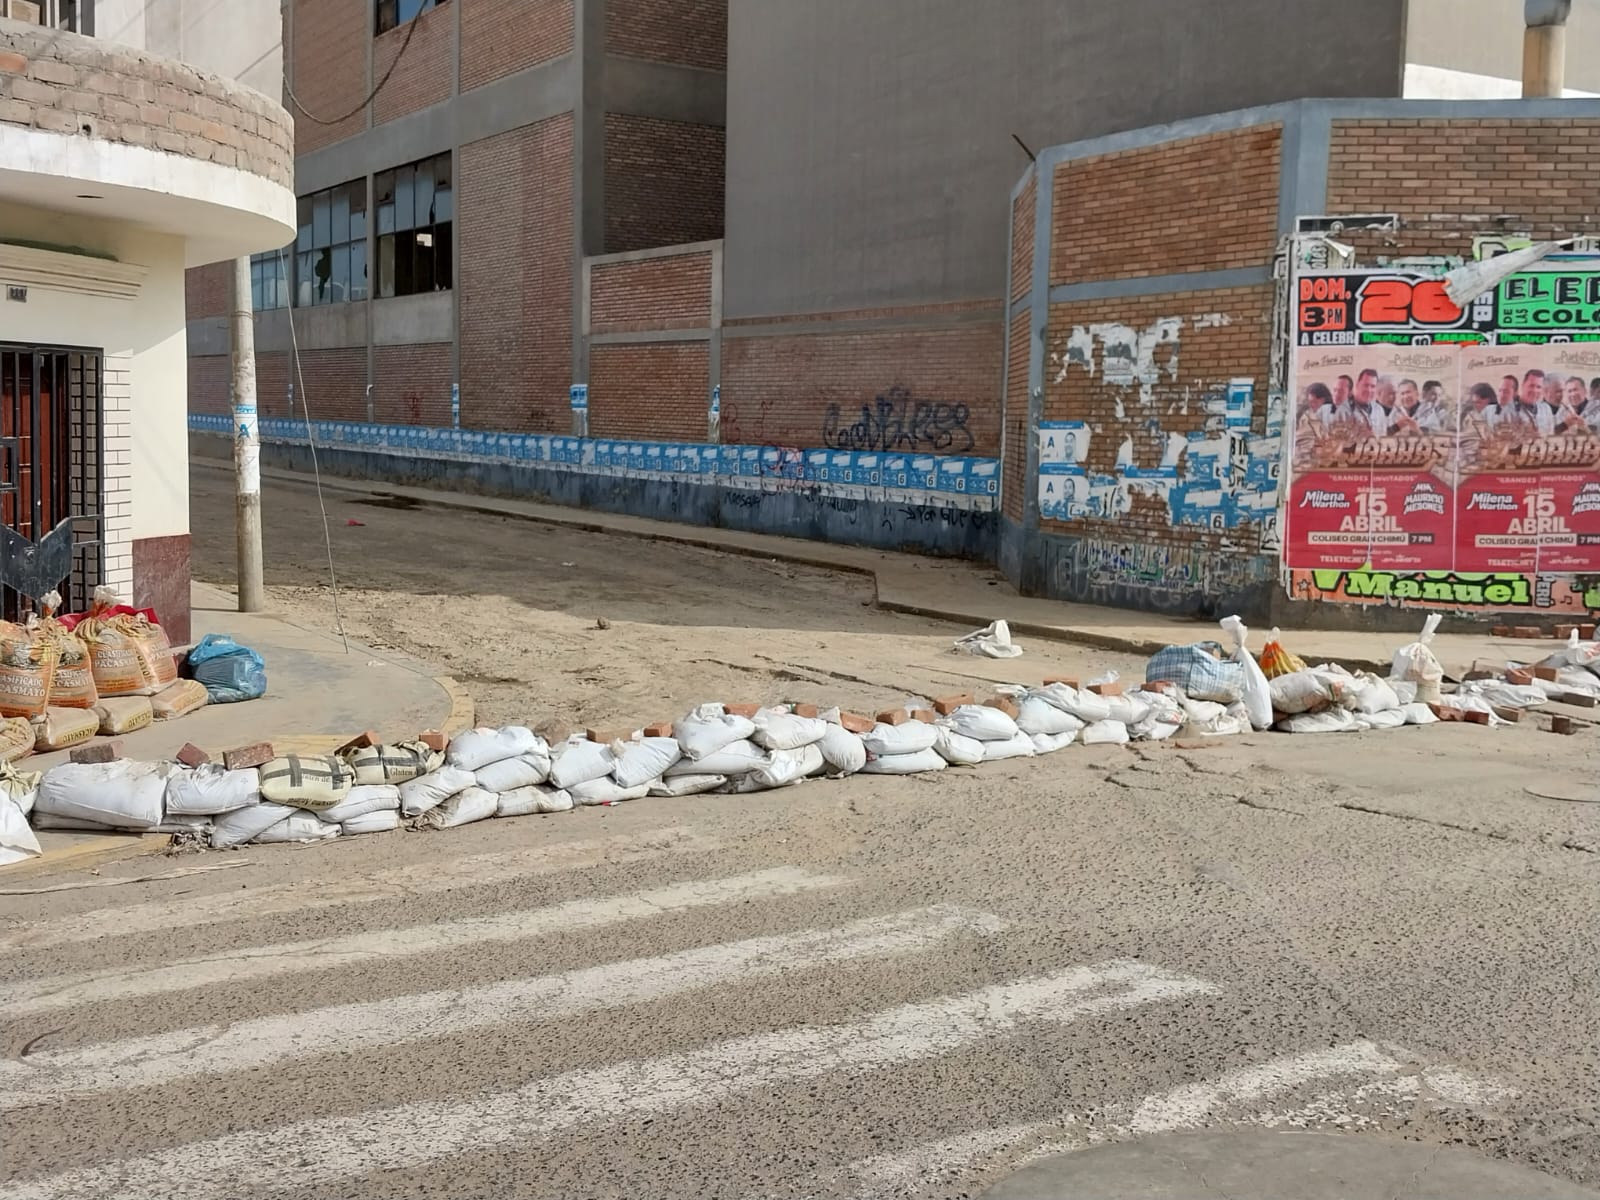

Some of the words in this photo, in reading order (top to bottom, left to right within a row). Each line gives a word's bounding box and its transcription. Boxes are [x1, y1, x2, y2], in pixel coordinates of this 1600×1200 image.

[1300, 277, 1352, 301] DOM.
[1504, 277, 1550, 300] EL
[1303, 306, 1326, 327] 3
[1327, 308, 1343, 324] PM
[1503, 308, 1513, 323] DE
[1301, 332, 1309, 345] A
[1047, 437, 1055, 448] A
[1046, 481, 1055, 493] A
[1300, 490, 1346, 508] Milena
[1312, 500, 1350, 509] Warthon
[1355, 493, 1388, 516] 15
[1466, 491, 1514, 510] Milena
[1479, 502, 1518, 511] Warthon
[1523, 494, 1556, 518] 15
[1212, 515, 1222, 528] 6
[1339, 515, 1403, 532] ABRIL
[1507, 516, 1572, 534] ABRIL
[1311, 534, 1349, 543] COLISEO
[1350, 535, 1376, 544] GRAN
[1418, 535, 1433, 544] PM
[1479, 536, 1516, 546] COLISEO
[1346, 571, 1530, 604] Manuel
